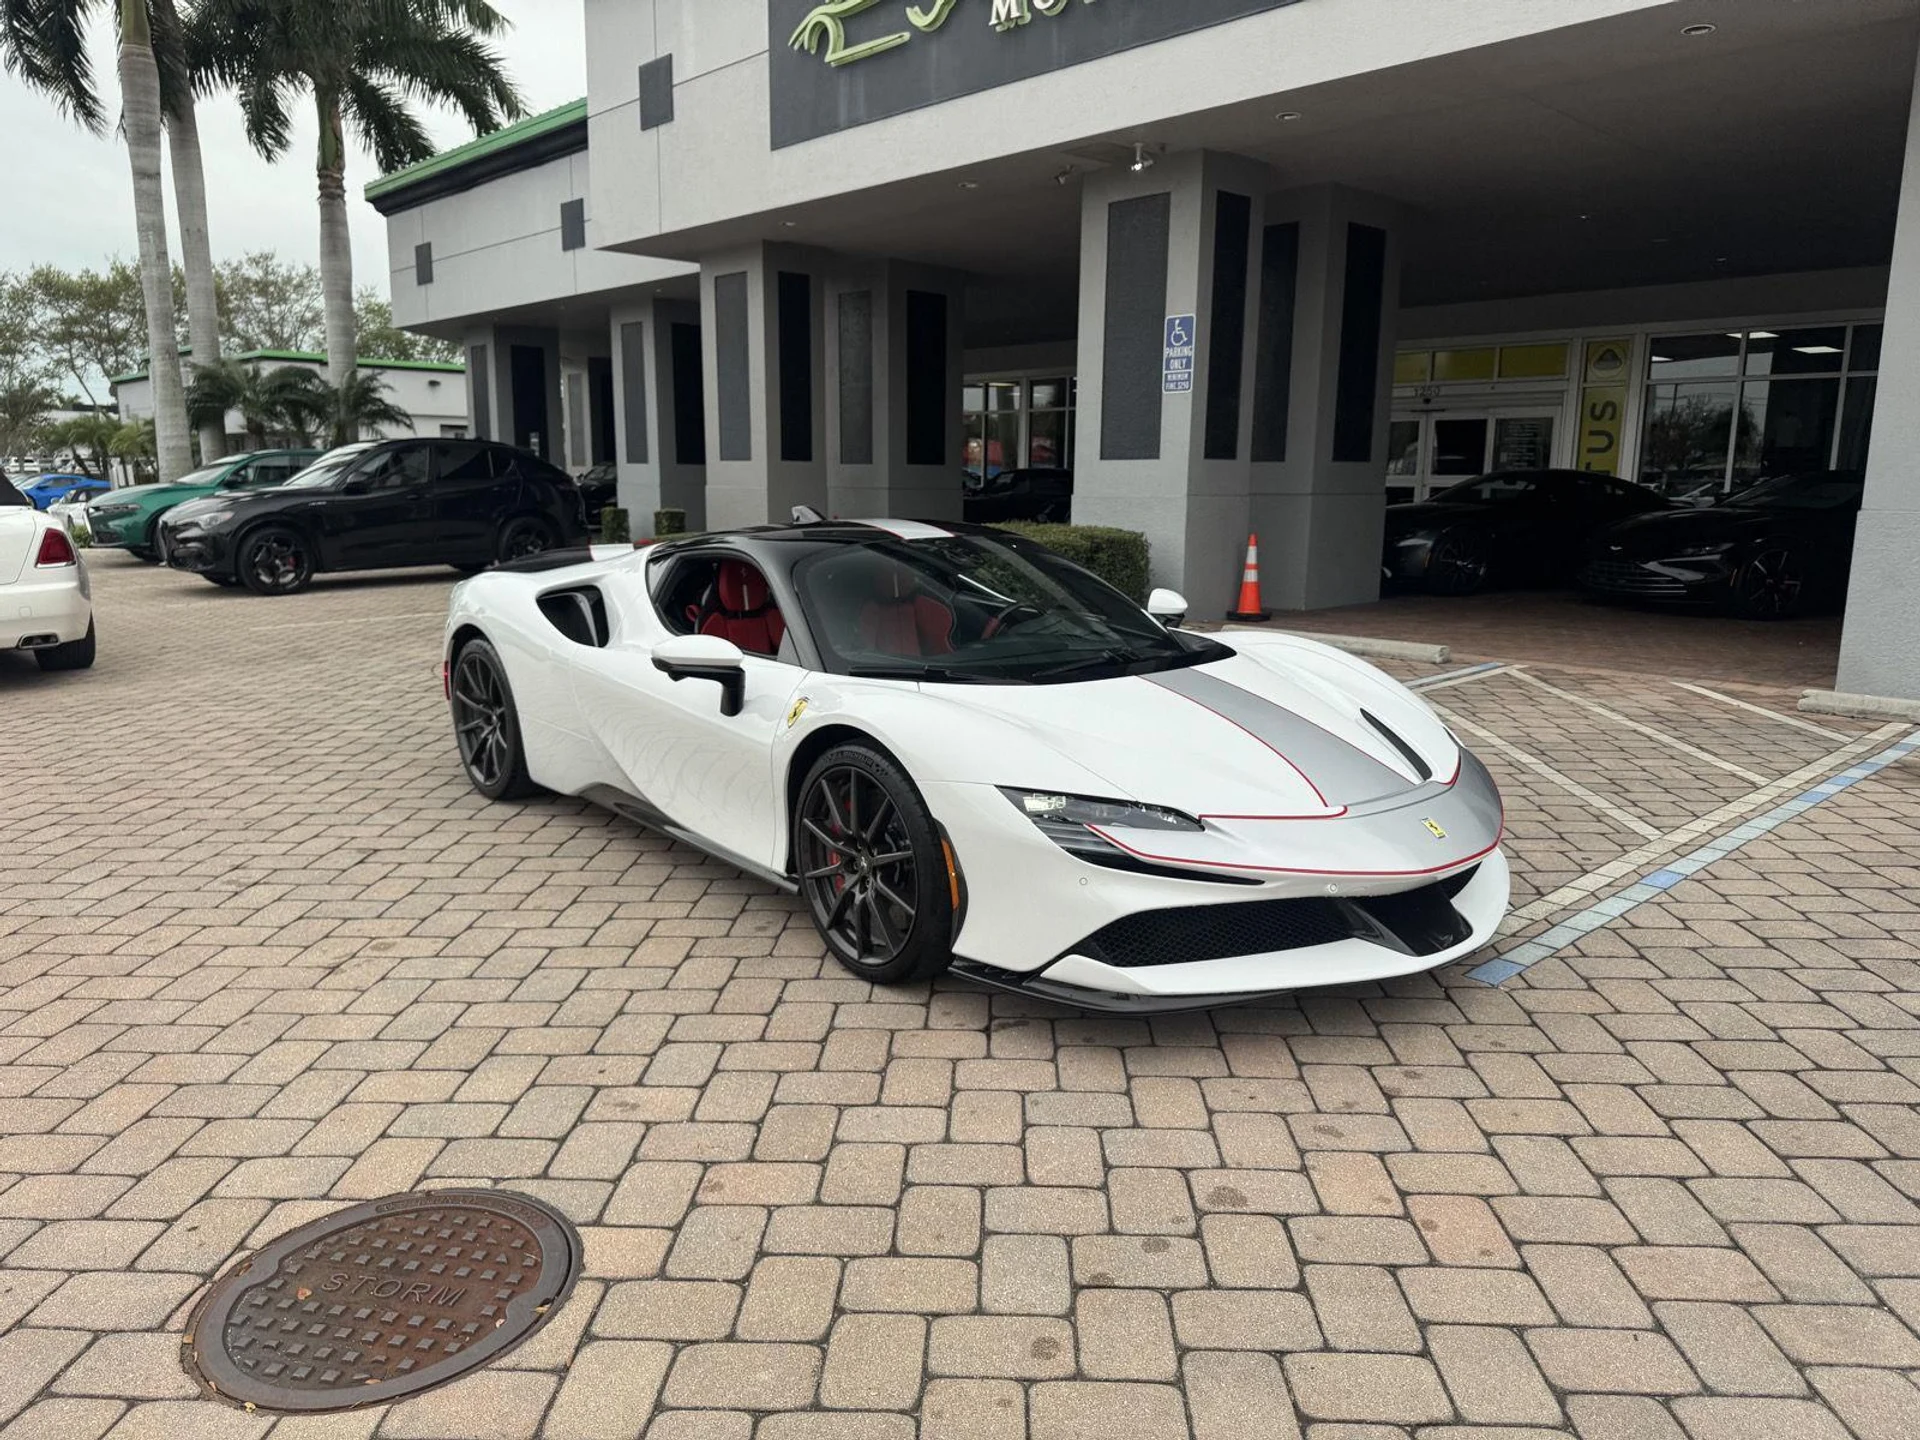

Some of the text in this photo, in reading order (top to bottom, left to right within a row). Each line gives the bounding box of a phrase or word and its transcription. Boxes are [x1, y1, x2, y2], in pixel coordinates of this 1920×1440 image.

[1165, 346, 1192, 357] PARKING
[1170, 358, 1186, 369] ONLY
[322, 1273, 467, 1307] STORM
